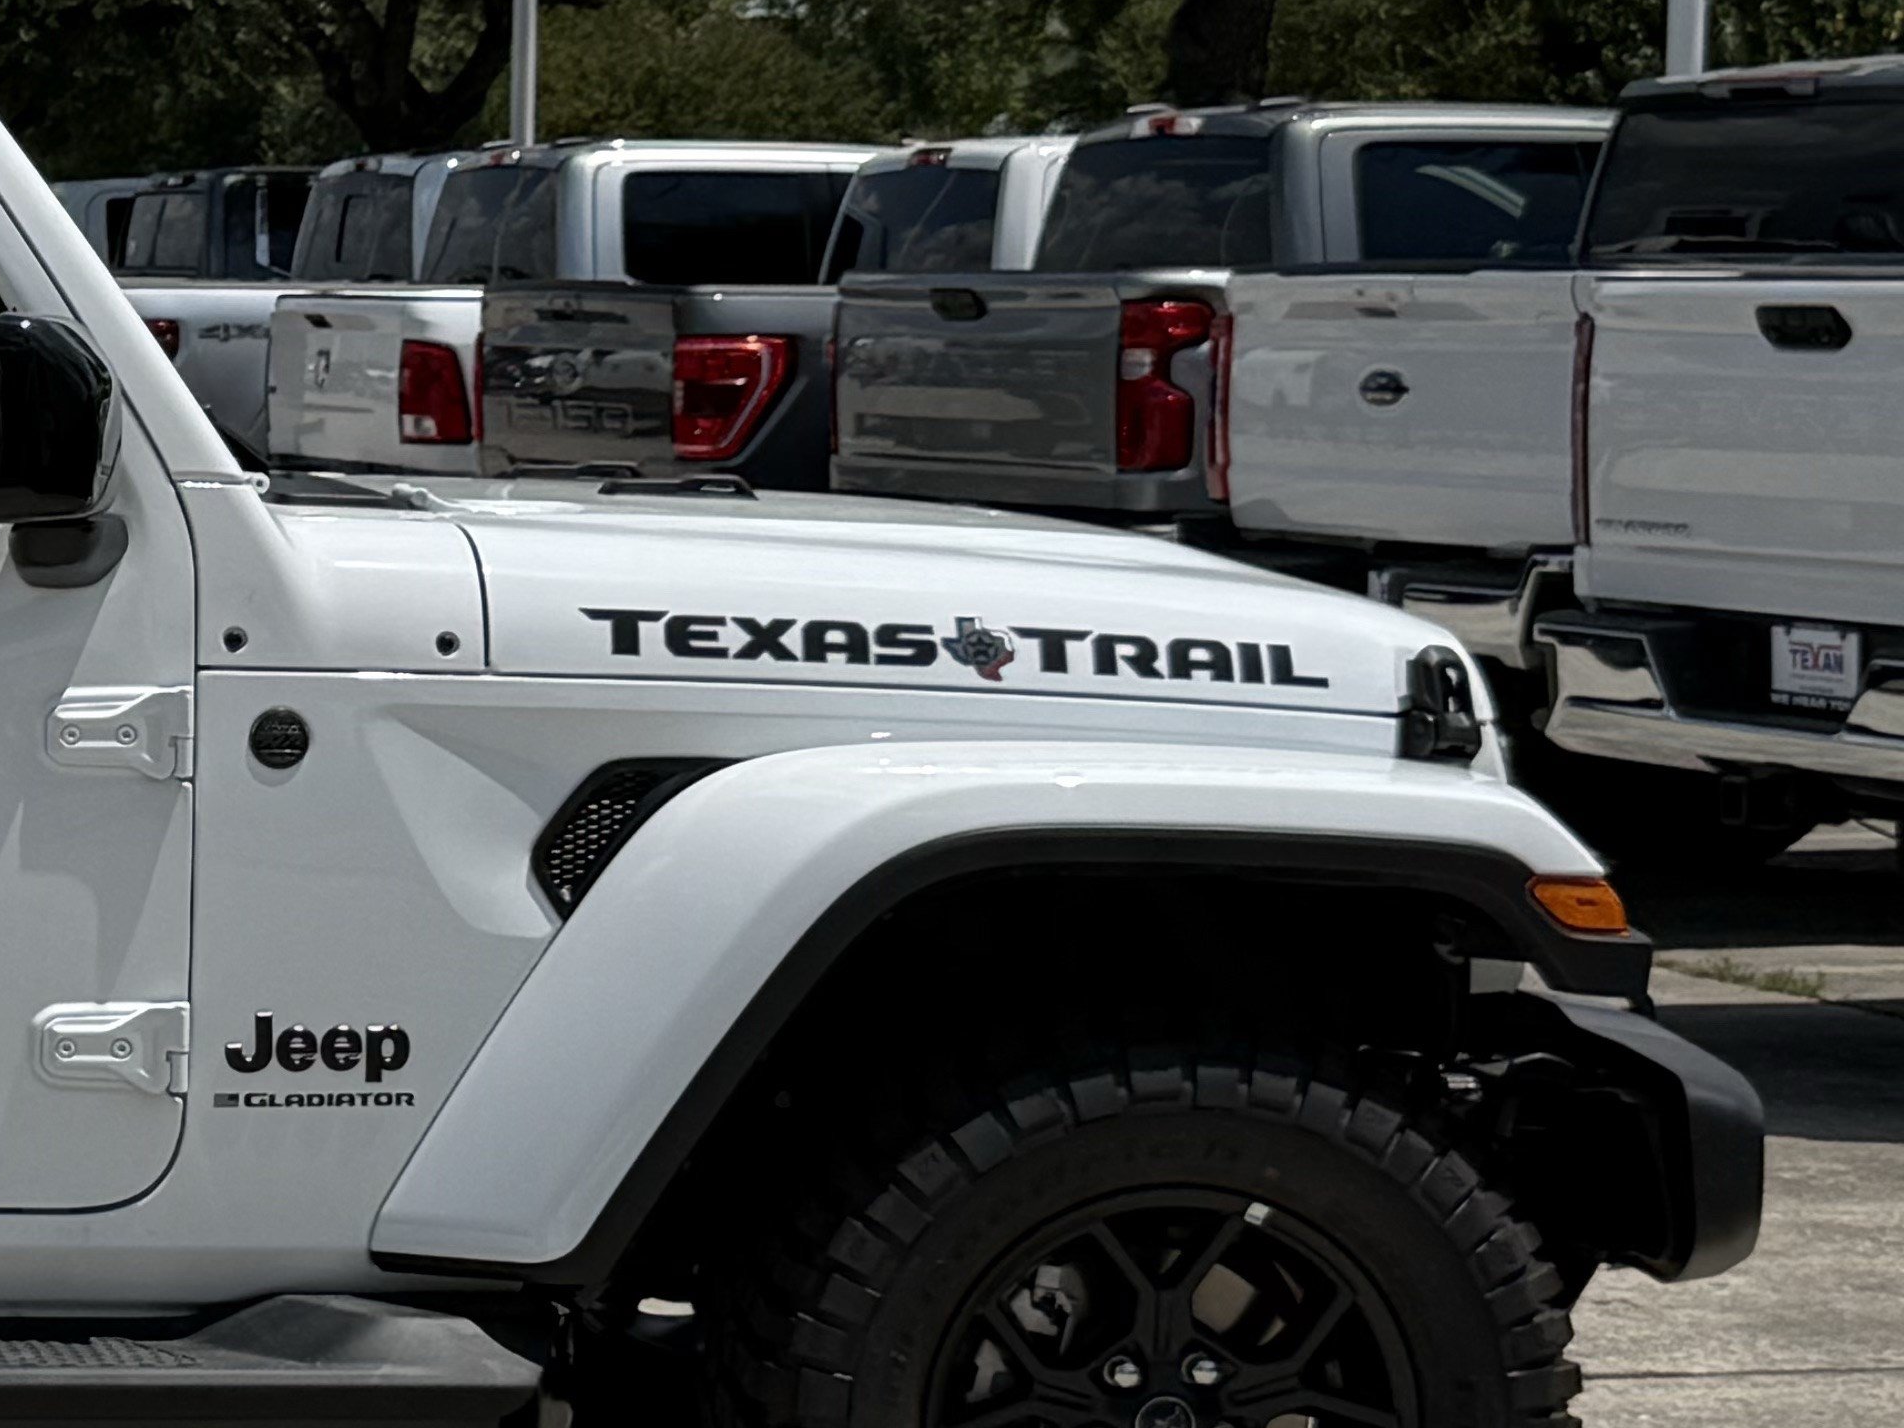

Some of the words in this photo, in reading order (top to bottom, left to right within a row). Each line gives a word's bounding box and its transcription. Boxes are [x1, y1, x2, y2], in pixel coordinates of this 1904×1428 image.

[577, 607, 939, 667] TEXAS
[1007, 625, 1330, 689] TRAIL
[1789, 641, 1844, 675] TEXAN
[224, 1010, 411, 1083] Jeep
[243, 1091, 416, 1108] GLADIATOR
